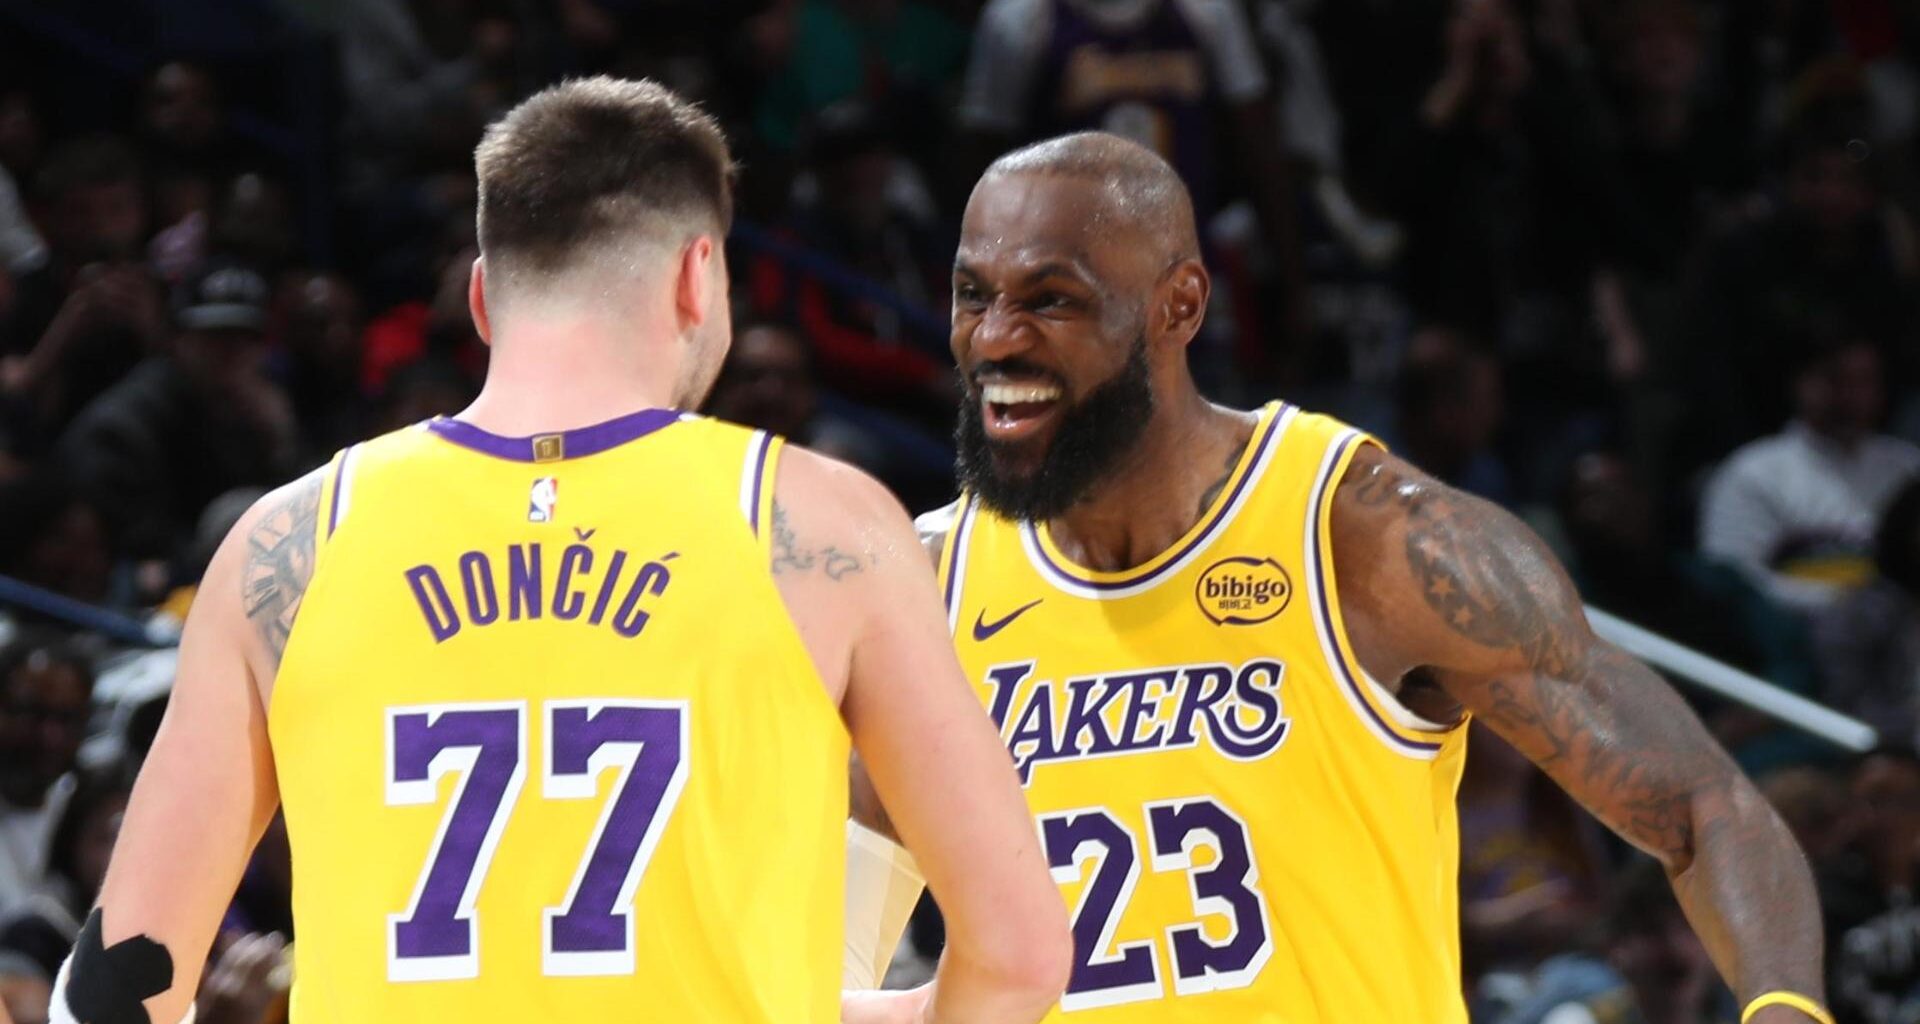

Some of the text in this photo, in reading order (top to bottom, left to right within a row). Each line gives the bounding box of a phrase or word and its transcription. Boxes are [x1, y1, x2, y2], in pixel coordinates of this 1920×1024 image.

[404, 527, 681, 644] DONČIĆ
[1206, 575, 1285, 604] bibigo
[984, 657, 1292, 788] LAKERS
[385, 699, 690, 982] 77
[1035, 796, 1274, 1012] 23
